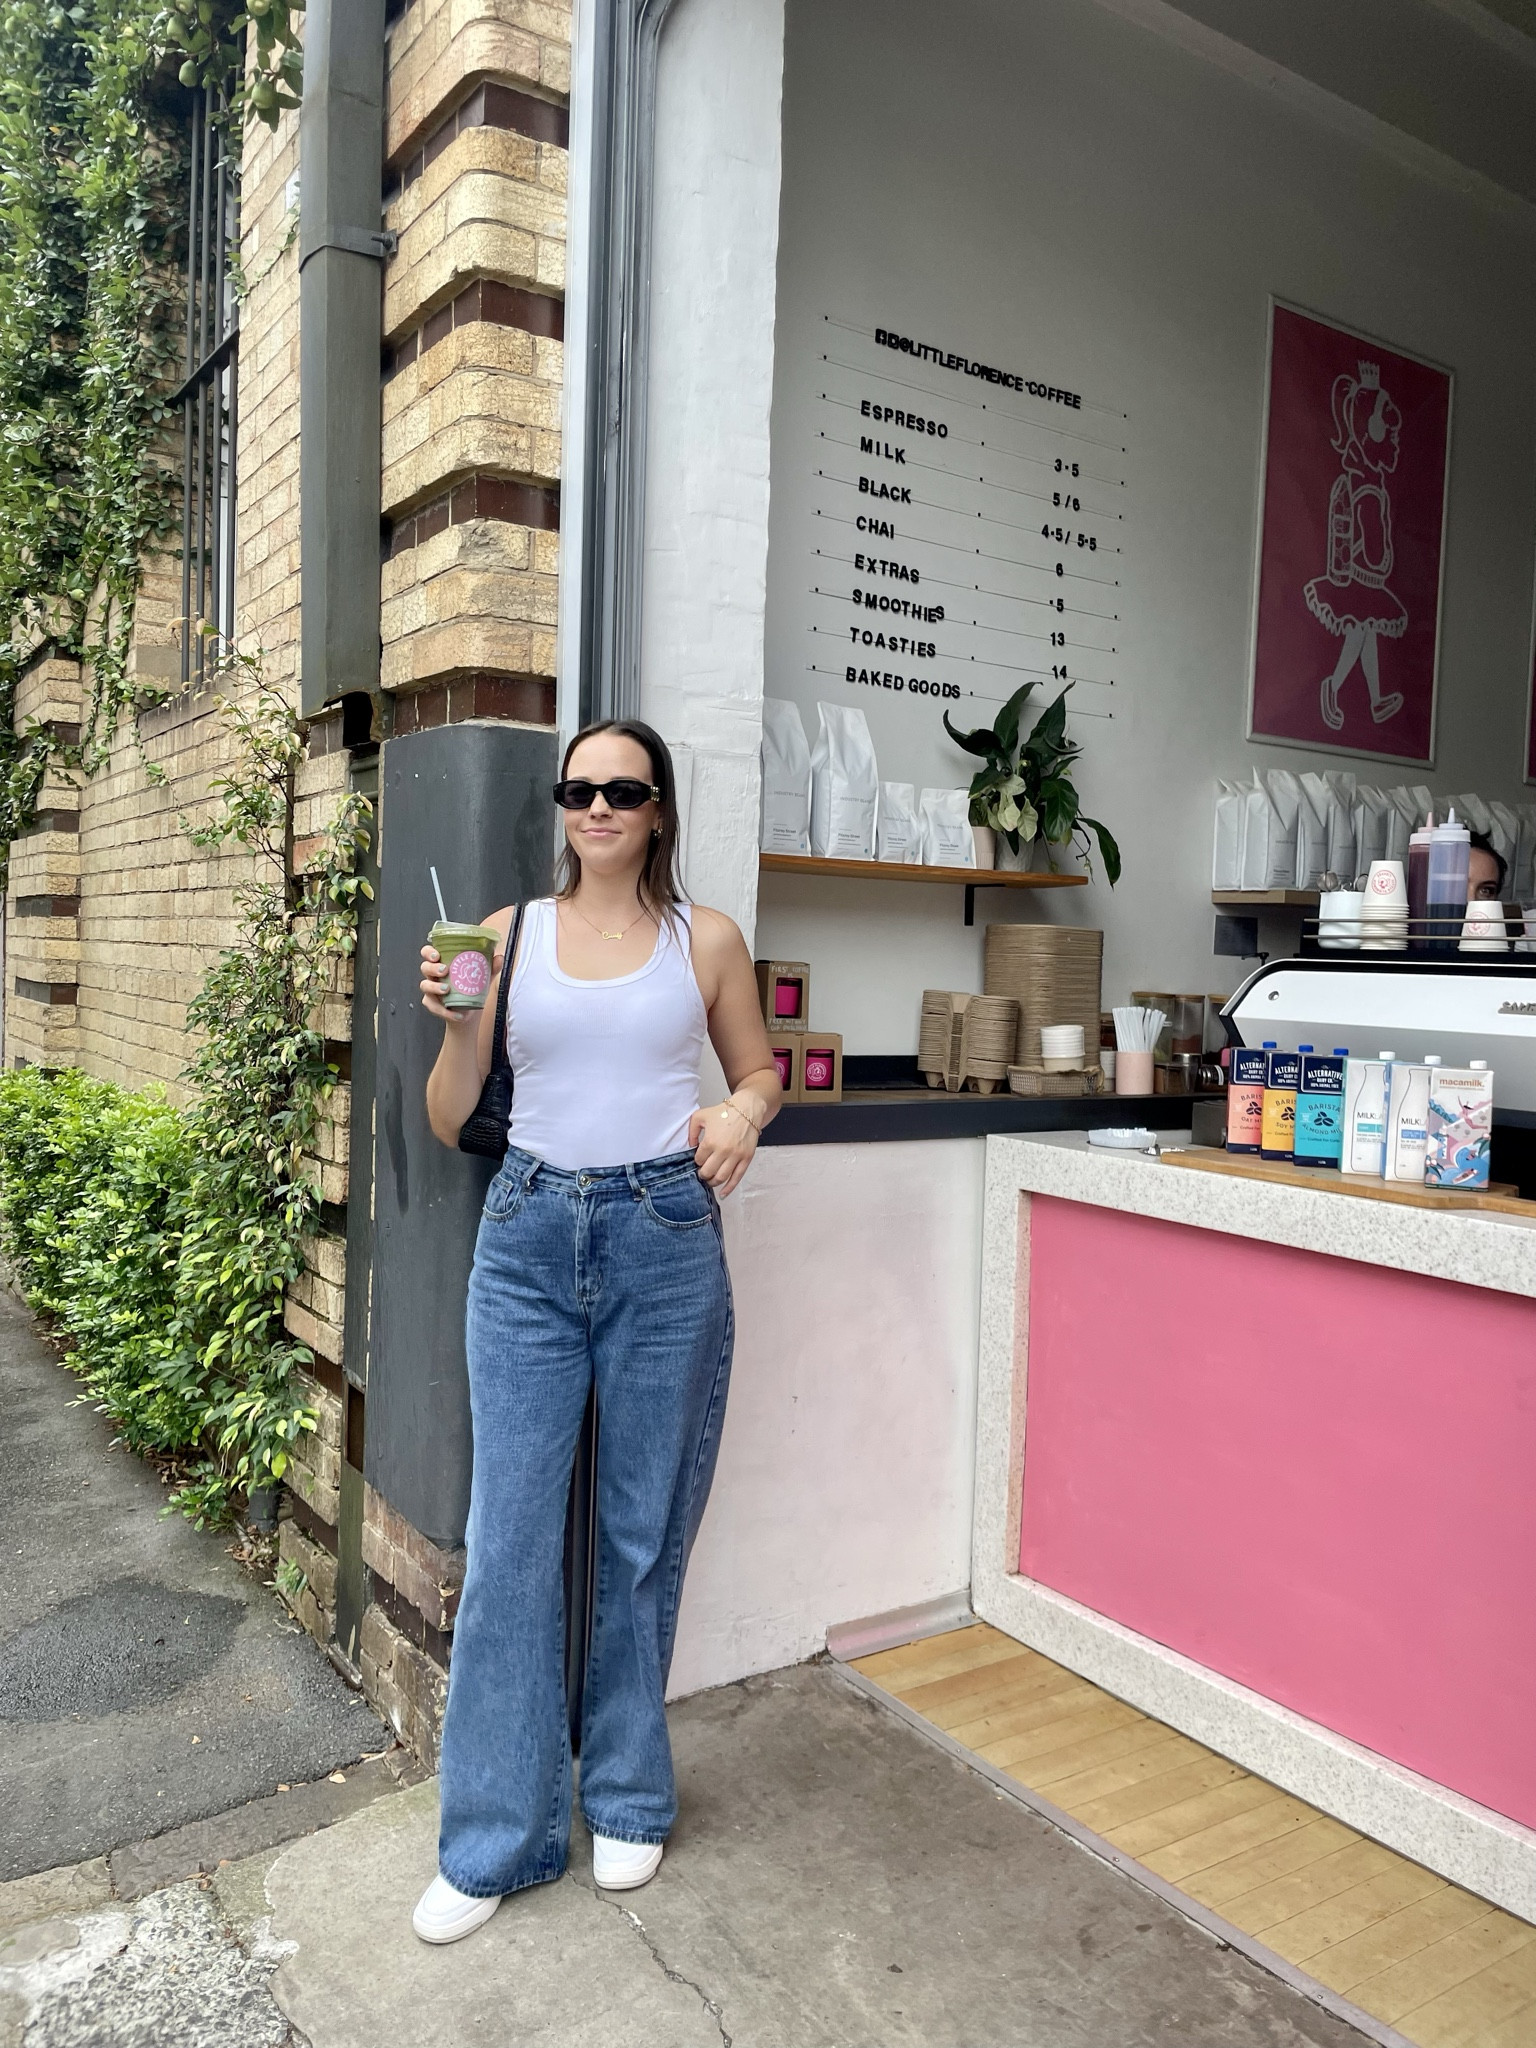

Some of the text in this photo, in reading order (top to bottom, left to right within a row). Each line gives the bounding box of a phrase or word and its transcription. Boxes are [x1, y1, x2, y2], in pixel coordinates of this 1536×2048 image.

[860, 399, 949, 439] ESPRESSO
[859, 436, 906, 465] MILK
[858, 476, 912, 505] BLACK
[856, 515, 1065, 578] CHAI 6
[854, 553, 921, 585] EXTRAS
[852, 588, 1066, 647] SMOOTHIES 13
[850, 626, 1069, 681] TOASTIES 14
[845, 666, 961, 700] BAKED GOODS
[451, 953, 470, 974] LITTLE
[454, 979, 480, 994] COFFEE
[1307, 1069, 1343, 1080] ALTERNATIVE
[1308, 1103, 1340, 1112] BARISTA
[1302, 1123, 1329, 1136] ALMOND
